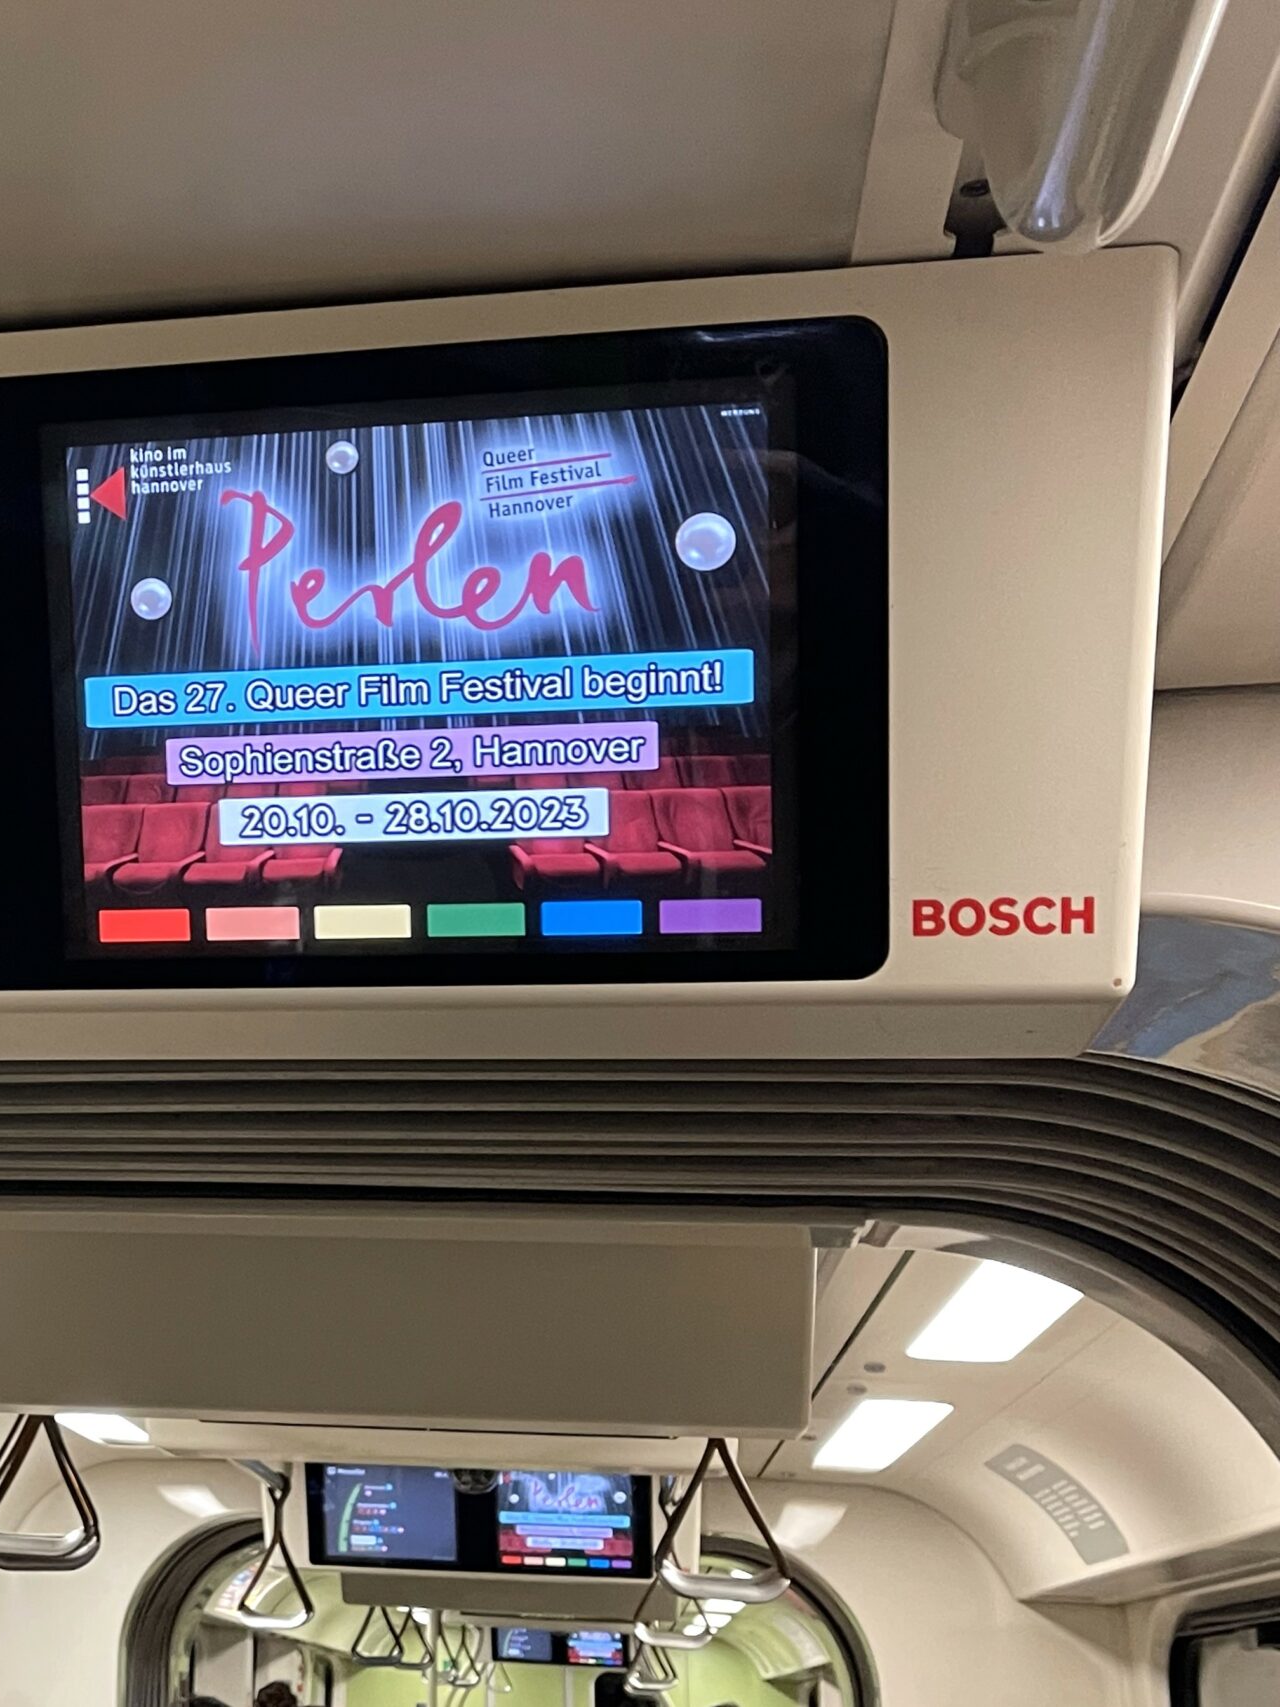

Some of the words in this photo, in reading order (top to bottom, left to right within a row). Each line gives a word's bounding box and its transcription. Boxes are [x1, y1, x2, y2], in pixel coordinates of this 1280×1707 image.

[129, 447, 164, 464] kino
[167, 446, 187, 461] im
[130, 460, 232, 480] künstlerhaus
[482, 448, 536, 468] Queer
[131, 478, 204, 495] hannover
[485, 473, 524, 493] Film
[529, 461, 602, 487] Festival
[488, 494, 574, 518] Hannover
[220, 489, 601, 659] Perlen
[113, 685, 177, 716] Das
[184, 682, 237, 713] 27.
[246, 679, 349, 711] Queer
[358, 675, 430, 706] Film
[440, 667, 571, 702] Festival
[582, 660, 723, 702] beginnt!
[179, 739, 422, 783] Sophienstraße
[430, 737, 463, 773] 2,
[473, 734, 646, 768] Hannover
[239, 802, 346, 839] 20.10.
[355, 813, 374, 824] -
[382, 796, 588, 835] 28.10.2023
[912, 896, 1095, 937] BOSCH
